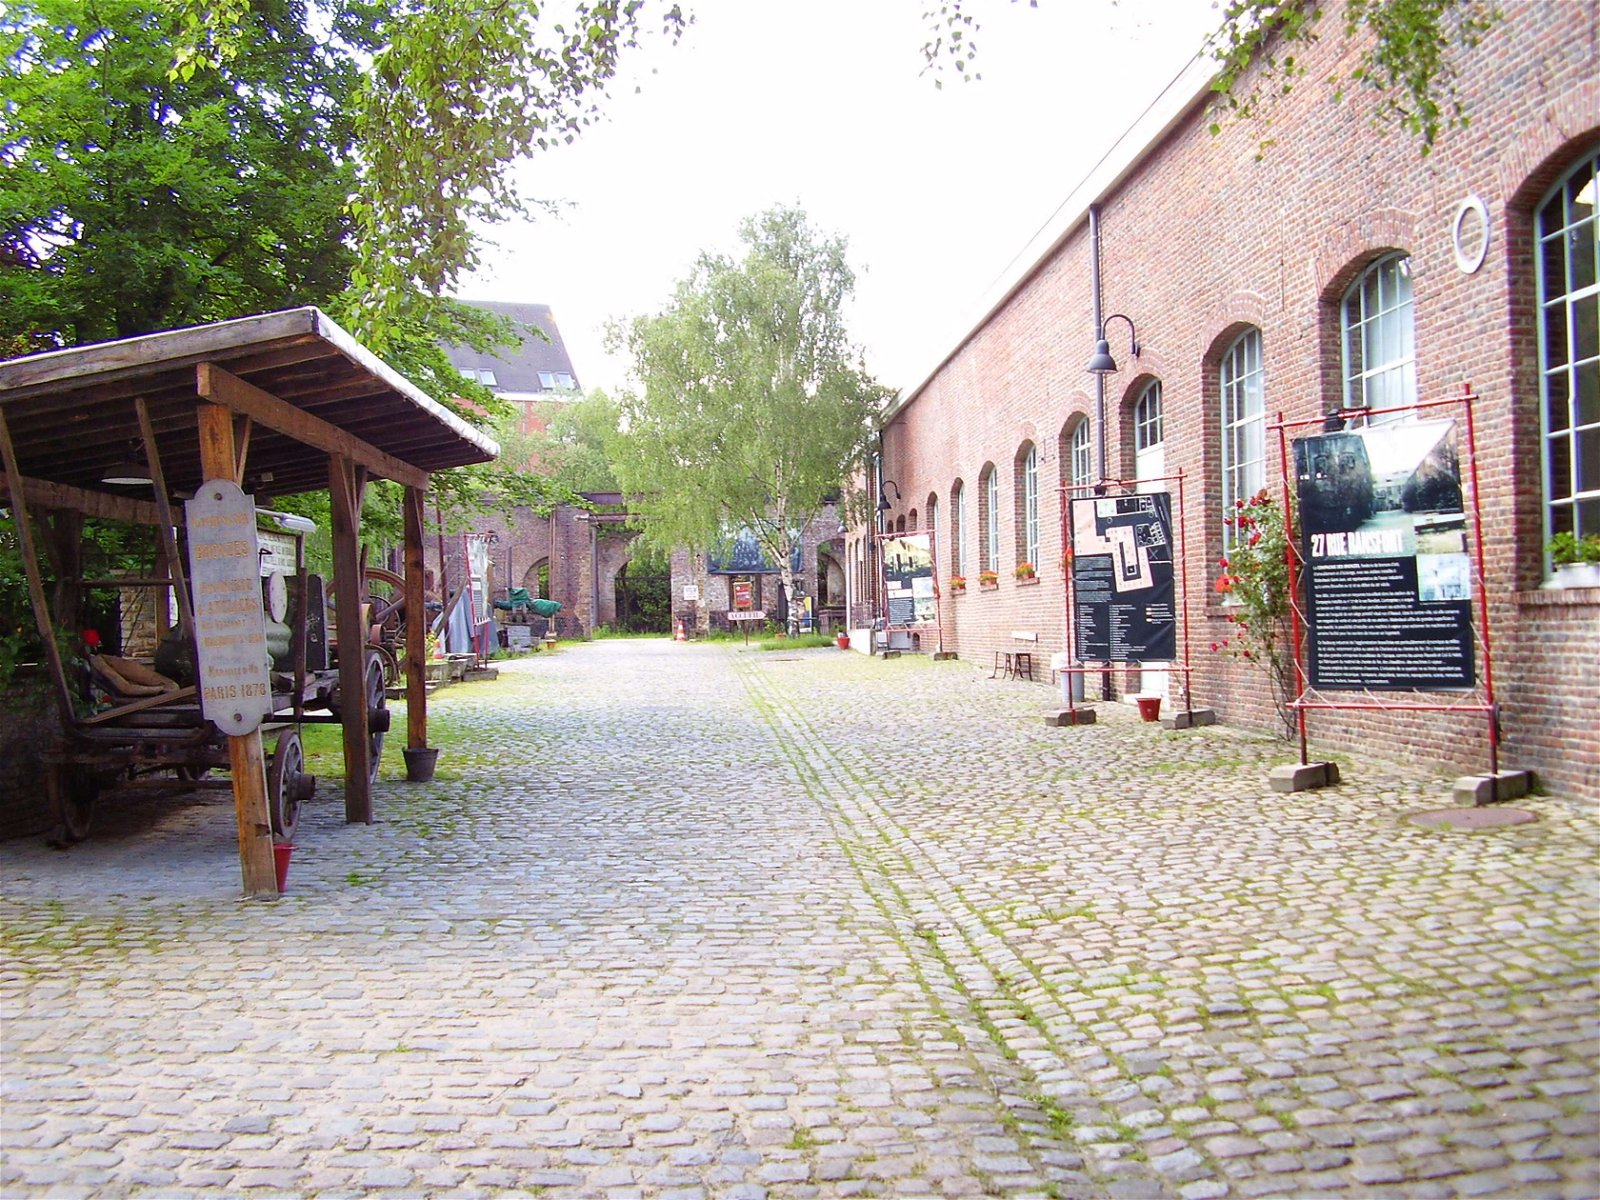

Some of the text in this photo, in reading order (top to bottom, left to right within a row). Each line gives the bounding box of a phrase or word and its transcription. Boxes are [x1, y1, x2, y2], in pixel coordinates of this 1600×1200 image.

[1310, 533, 1325, 557] 27
[1325, 532, 1347, 556] RUE
[204, 683, 266, 701] PARIS 1878
